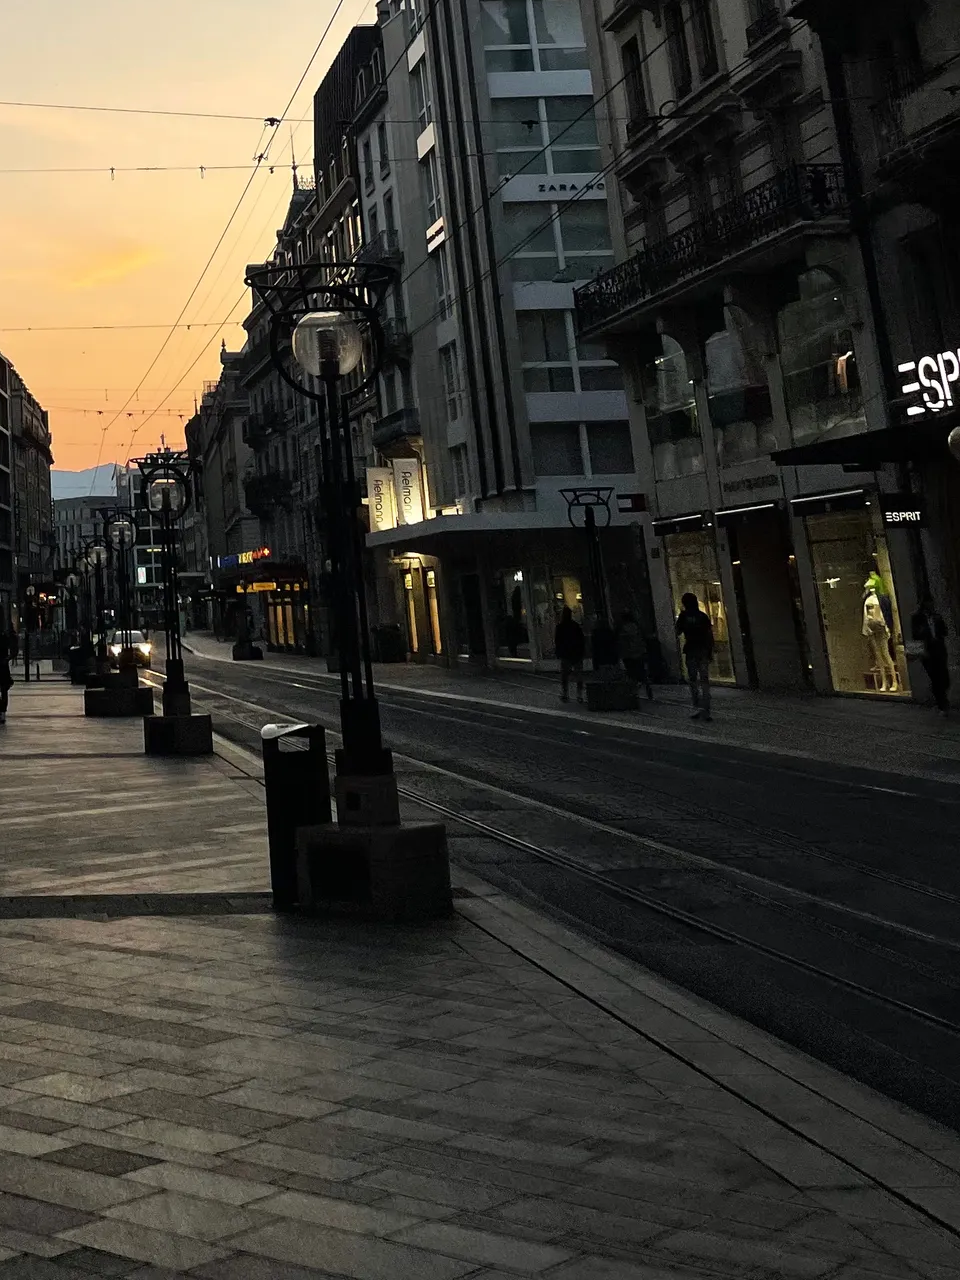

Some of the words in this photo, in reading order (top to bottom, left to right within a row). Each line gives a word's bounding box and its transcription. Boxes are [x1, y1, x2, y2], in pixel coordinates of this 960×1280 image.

[538, 183, 578, 193] ZARA
[897, 346, 960, 416] ESP
[885, 510, 921, 522] ESPRIT
